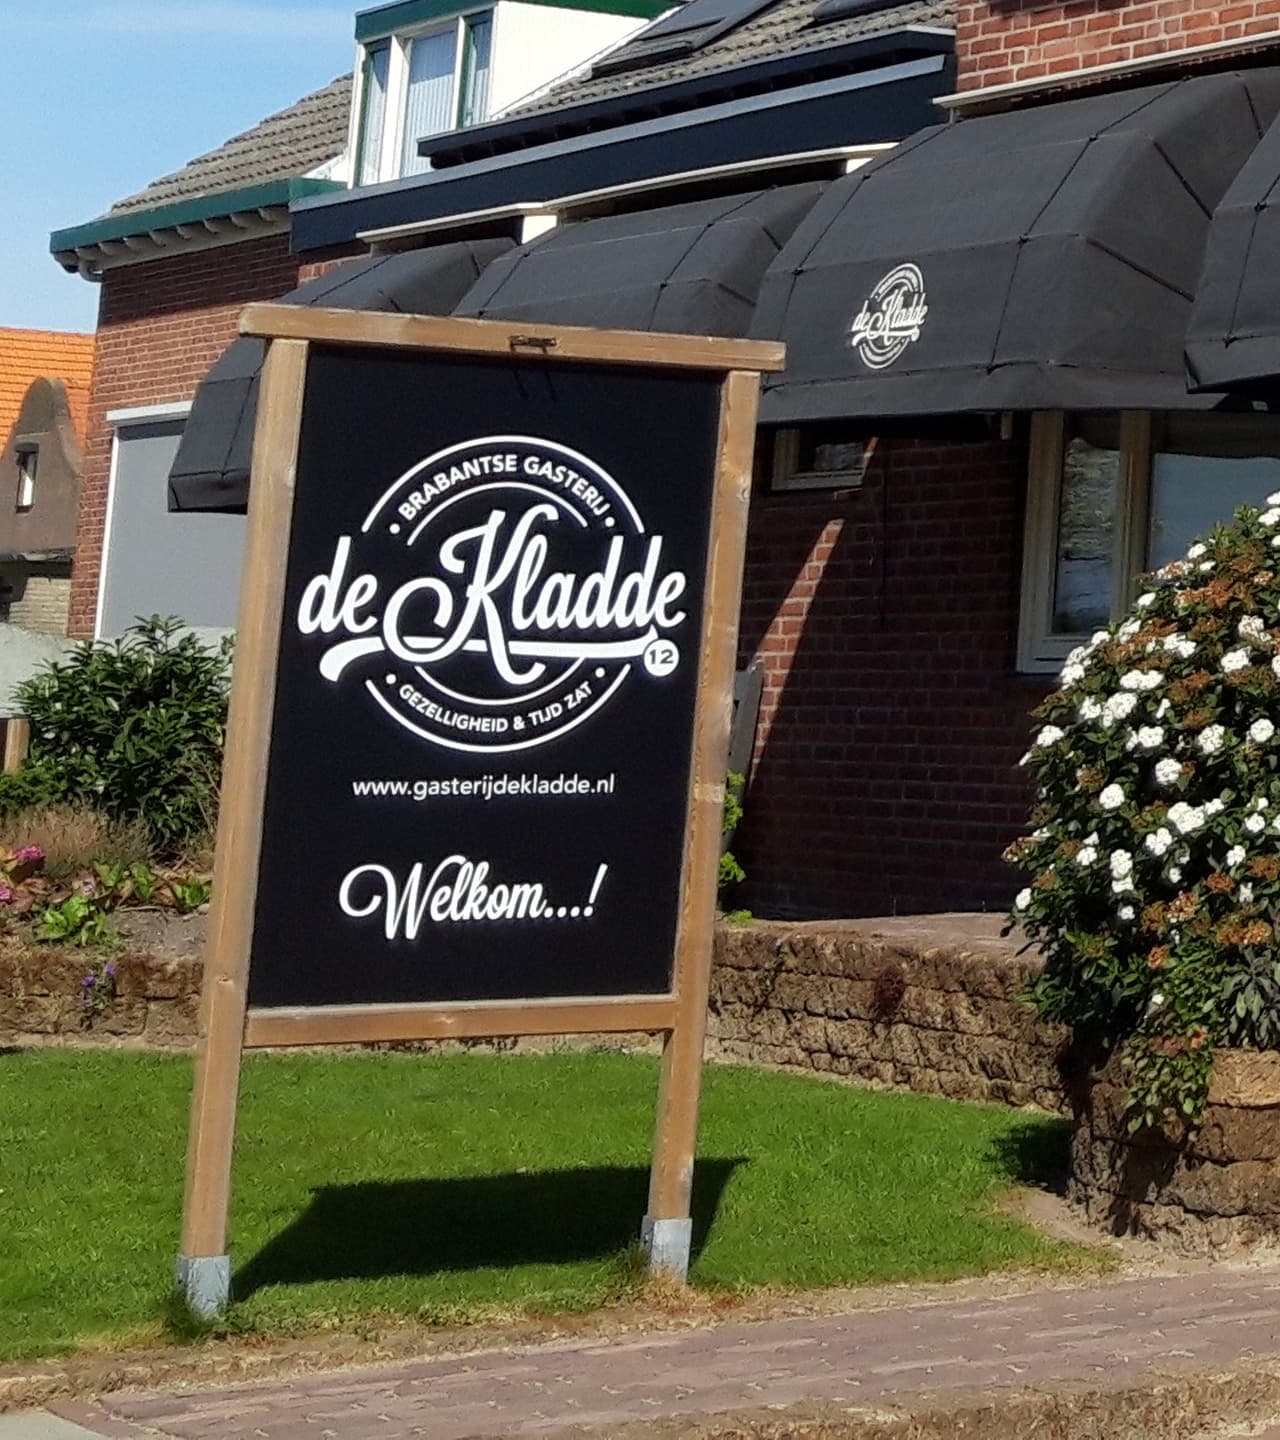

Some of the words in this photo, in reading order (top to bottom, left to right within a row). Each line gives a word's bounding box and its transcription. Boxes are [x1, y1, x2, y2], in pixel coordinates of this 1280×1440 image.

[851, 299, 871, 332] de
[866, 286, 929, 346] Kladde
[398, 454, 517, 521] BRABANTSE
[523, 455, 611, 517] GASTERIJ
[298, 535, 378, 634] de
[383, 503, 687, 686] Kladde
[649, 648, 674, 666] 12
[399, 683, 509, 733] GEZELLIGHEID
[512, 710, 526, 731] &
[528, 702, 563, 727] TIJD
[563, 680, 594, 710] ZAT
[352, 772, 615, 801] www.gasterijdekladde.nl
[338, 854, 609, 940] Welkom...!
